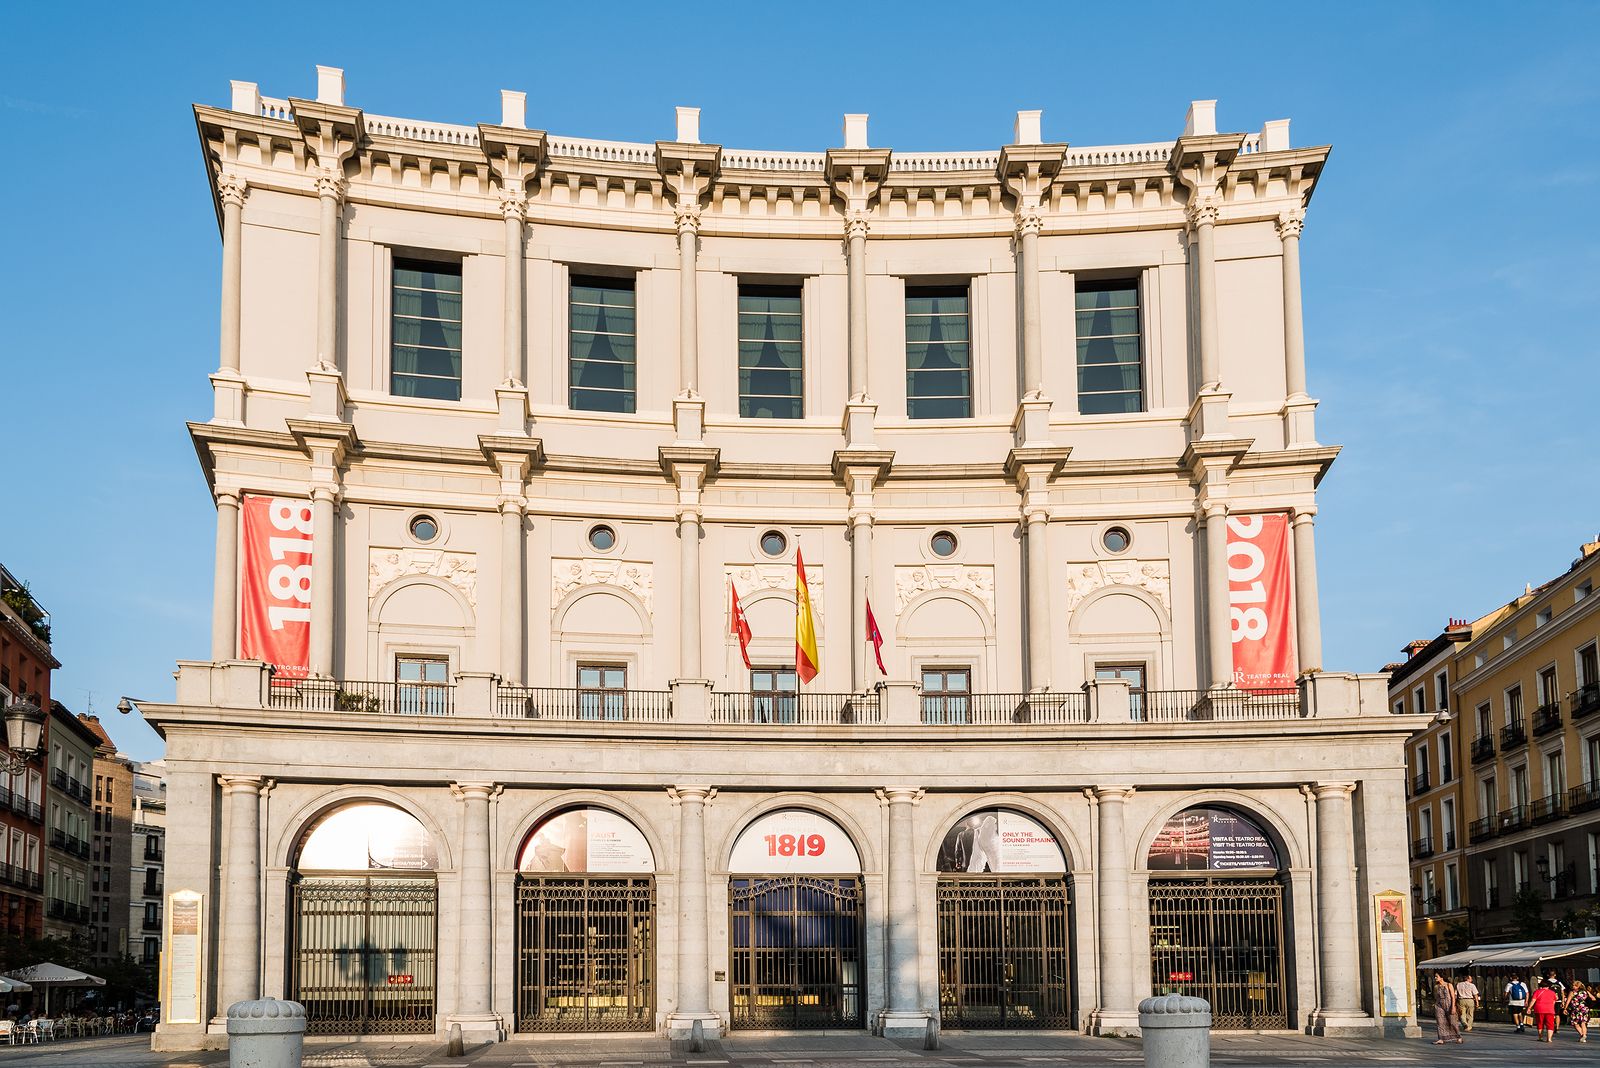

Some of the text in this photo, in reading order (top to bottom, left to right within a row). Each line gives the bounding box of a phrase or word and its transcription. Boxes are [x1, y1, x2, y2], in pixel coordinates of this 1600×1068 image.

[268, 498, 314, 631] 1818
[1225, 515, 1268, 643] 2018
[764, 834, 826, 856] 1819
